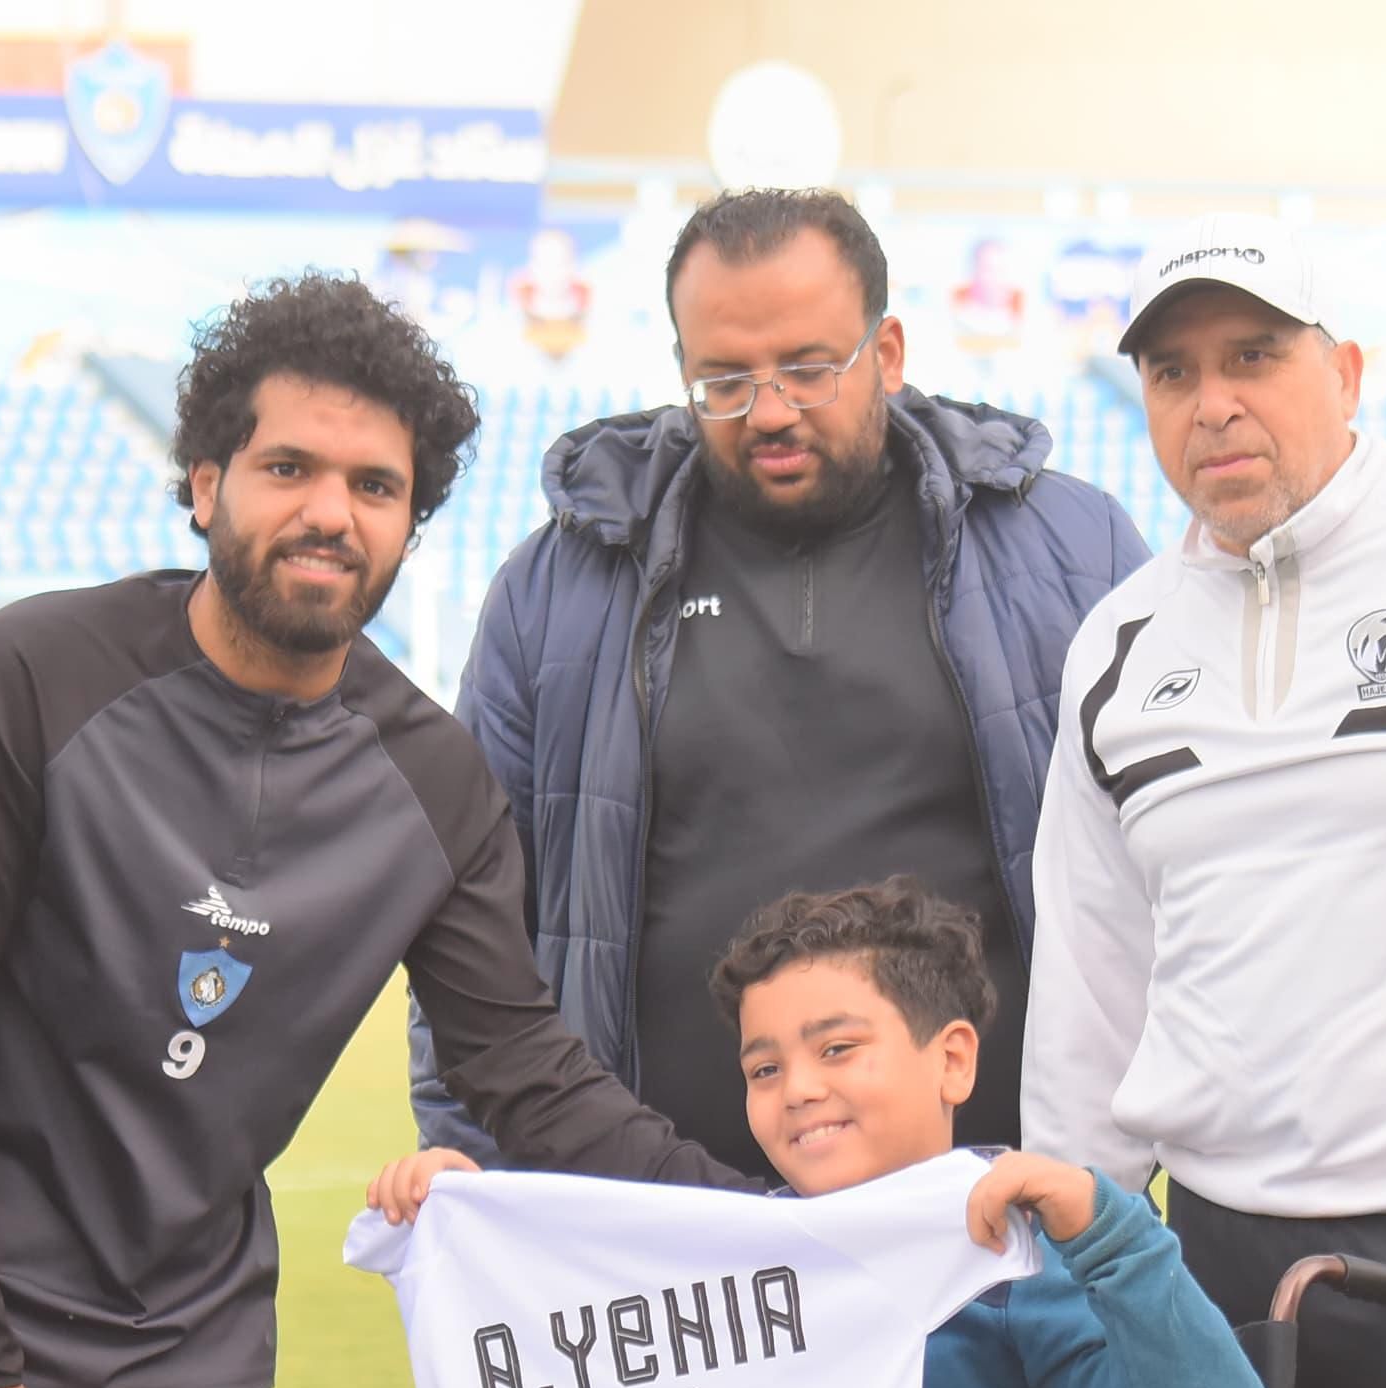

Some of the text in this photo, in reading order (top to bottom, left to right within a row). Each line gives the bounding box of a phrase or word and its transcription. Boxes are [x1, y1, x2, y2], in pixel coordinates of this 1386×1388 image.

[1159, 247, 1242, 278] uhlsport
[210, 910, 271, 936] tempo
[162, 1030, 207, 1080] 9
